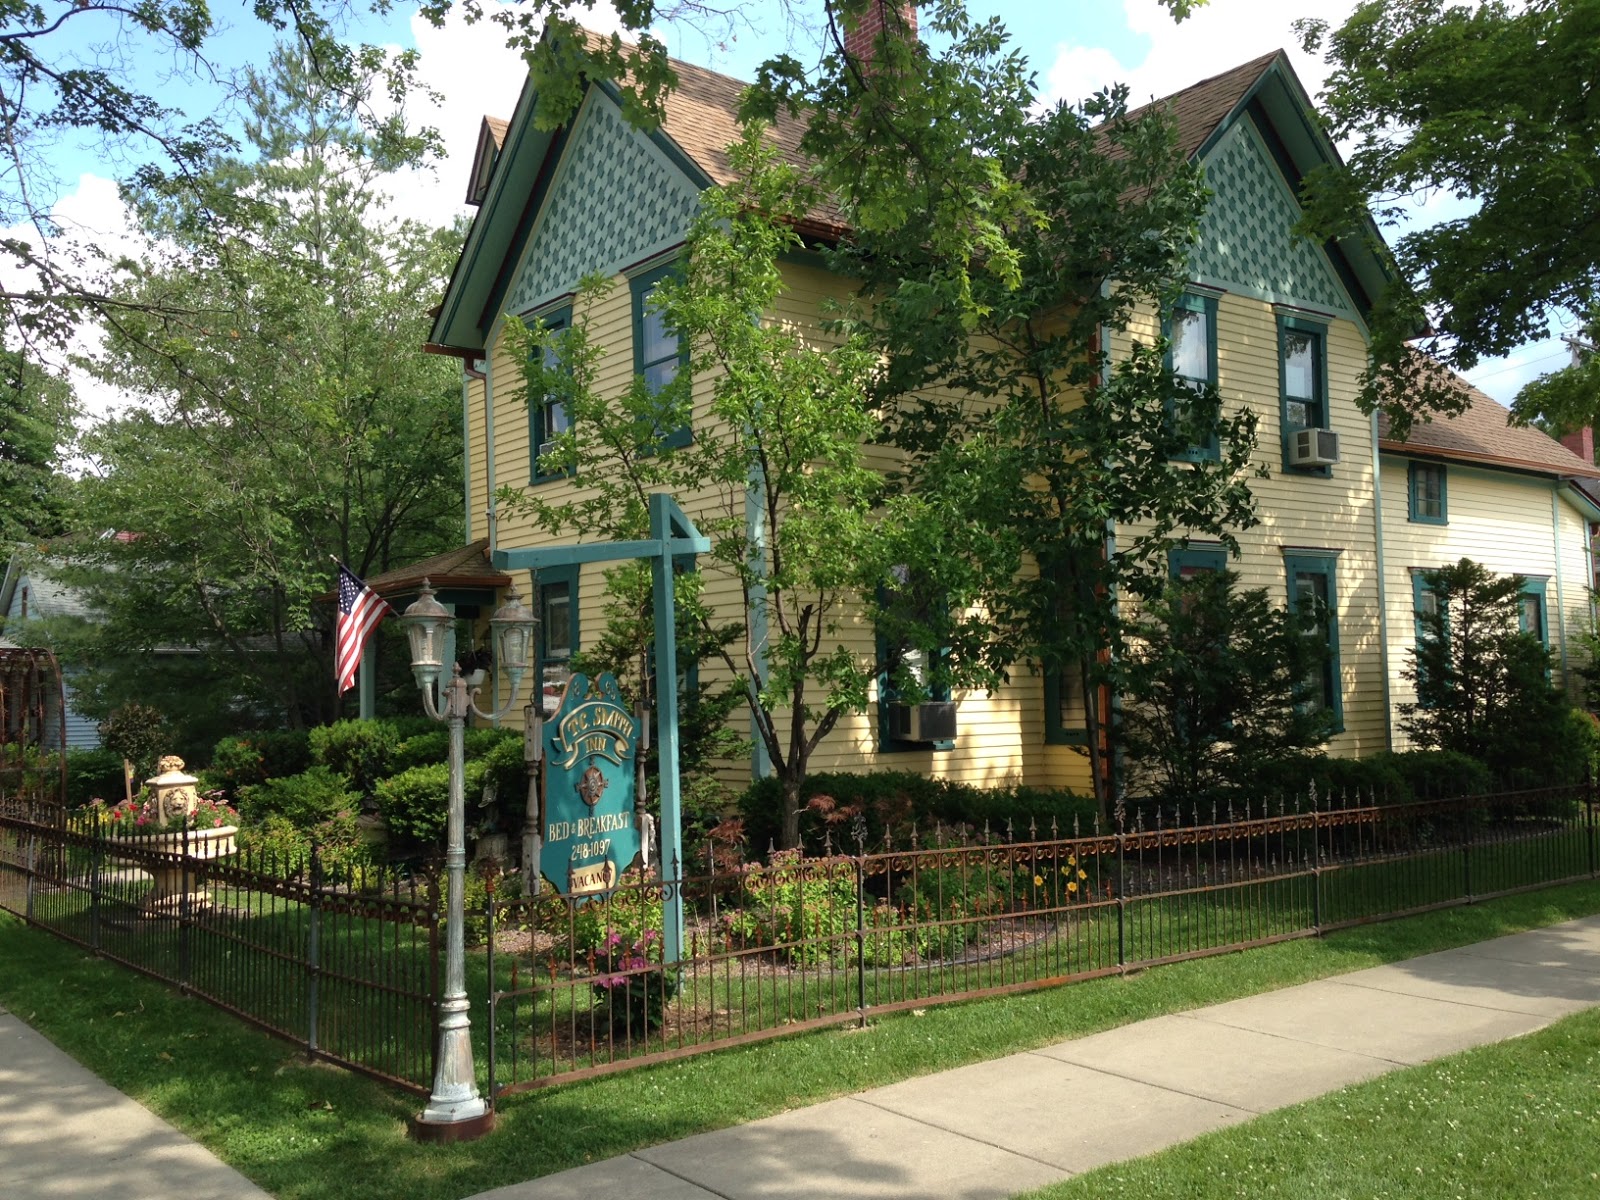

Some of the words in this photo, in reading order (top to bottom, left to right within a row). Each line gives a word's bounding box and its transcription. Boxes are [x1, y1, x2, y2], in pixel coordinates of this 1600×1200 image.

[593, 706, 634, 738] SMITH
[586, 736, 607, 754] INN
[549, 821, 570, 842] BED
[571, 823, 576, 834] &
[577, 811, 630, 840] BREAKFAST
[571, 838, 611, 861] 248-1097
[573, 869, 609, 889] VACAN
